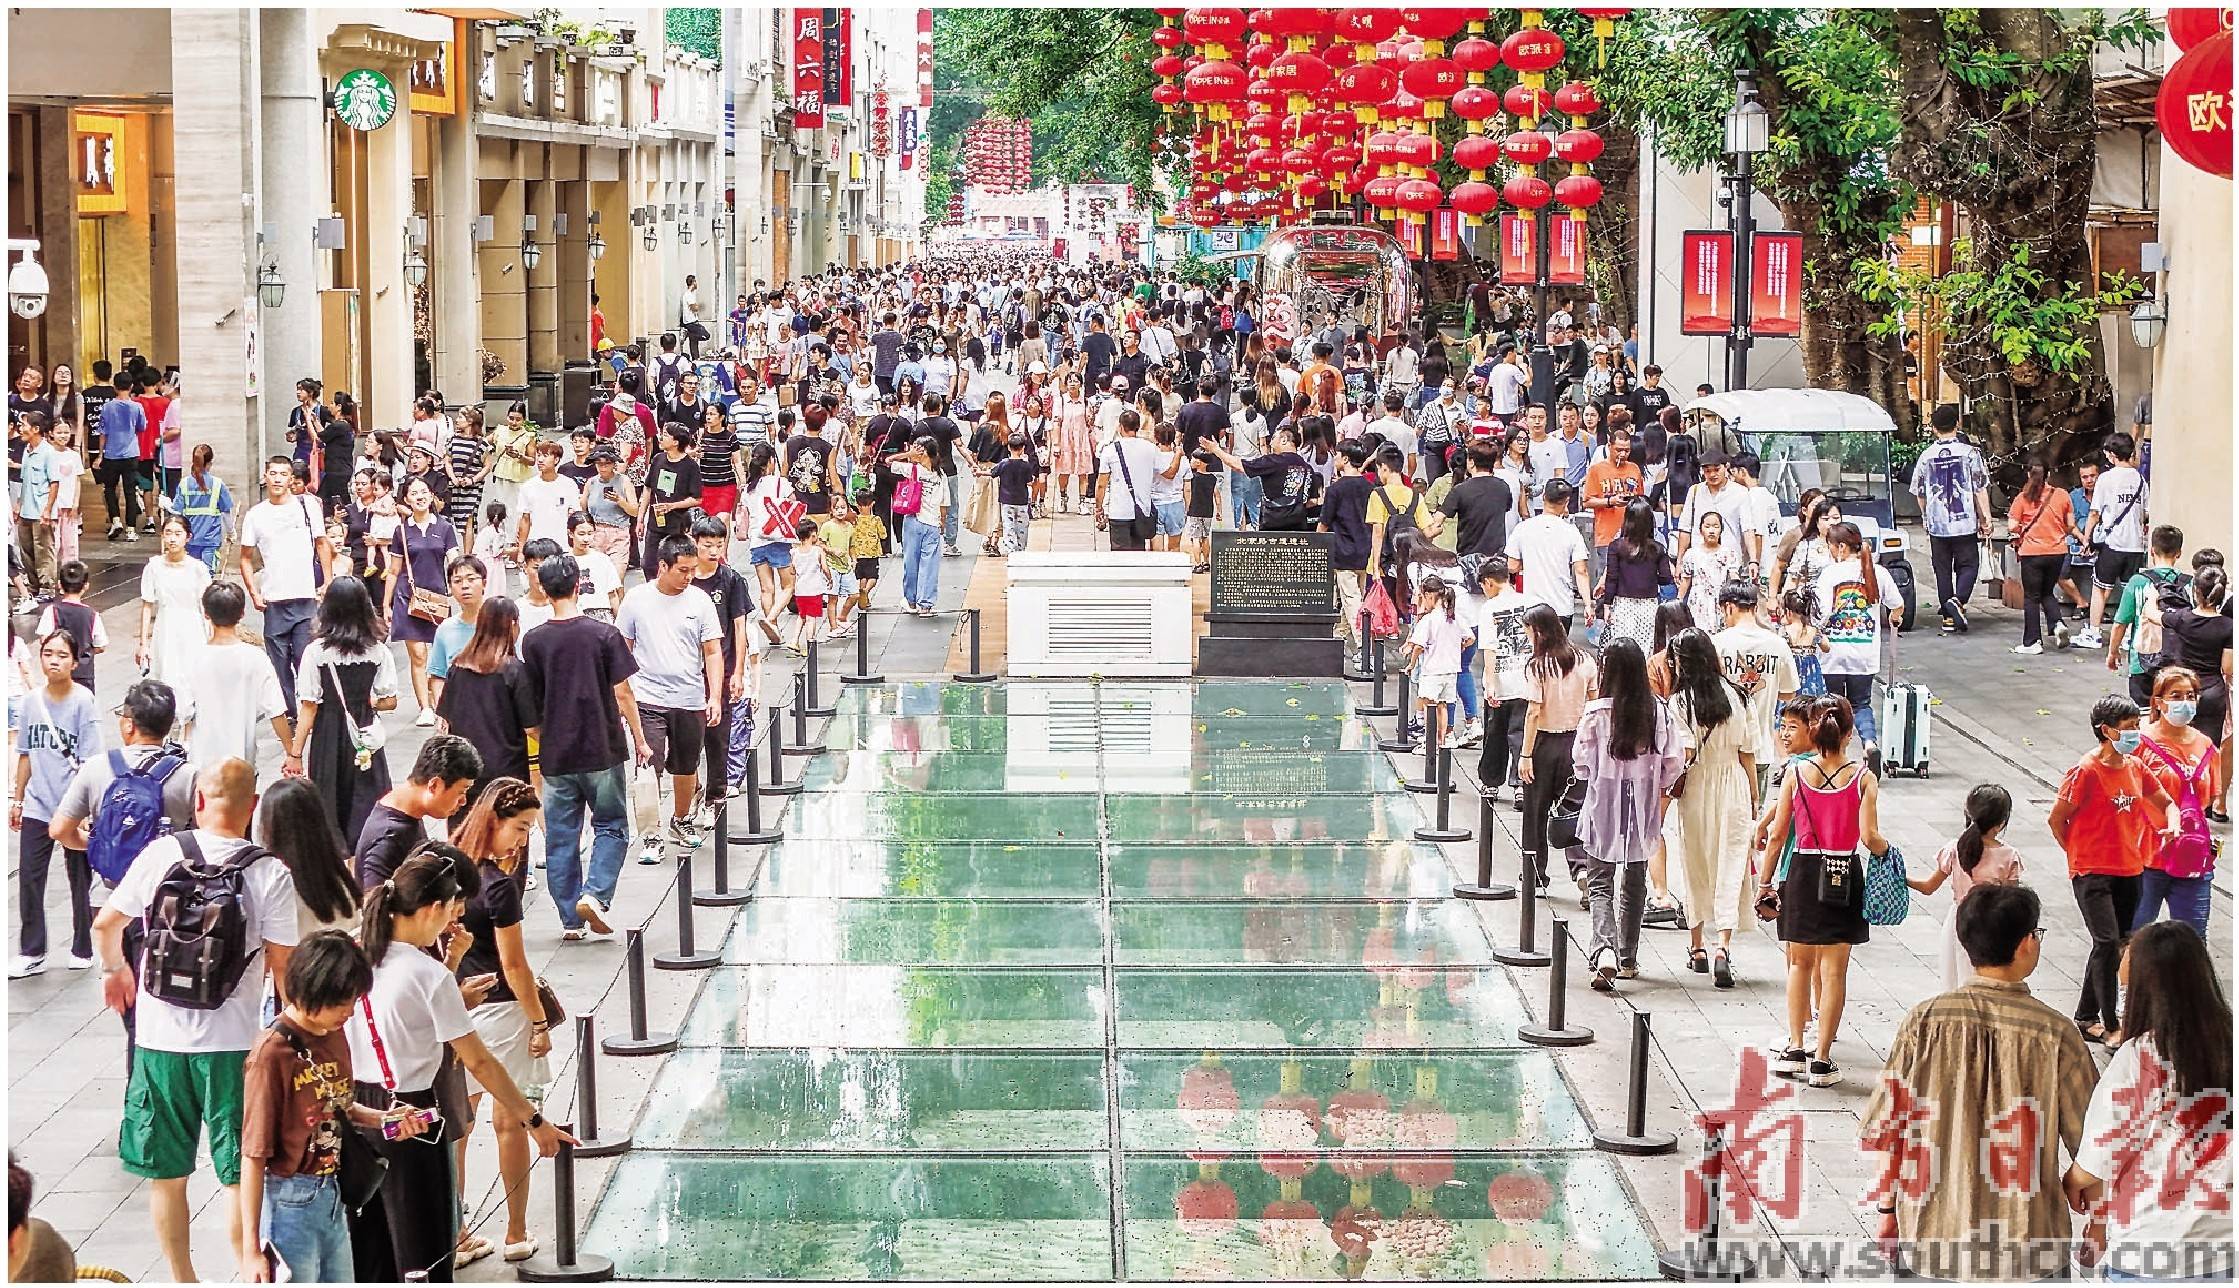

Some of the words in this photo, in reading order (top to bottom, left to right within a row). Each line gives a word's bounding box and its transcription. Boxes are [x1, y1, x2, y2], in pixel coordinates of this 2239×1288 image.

[797, 18, 821, 115] 周六福
[1724, 654, 1779, 675] RABBIT
